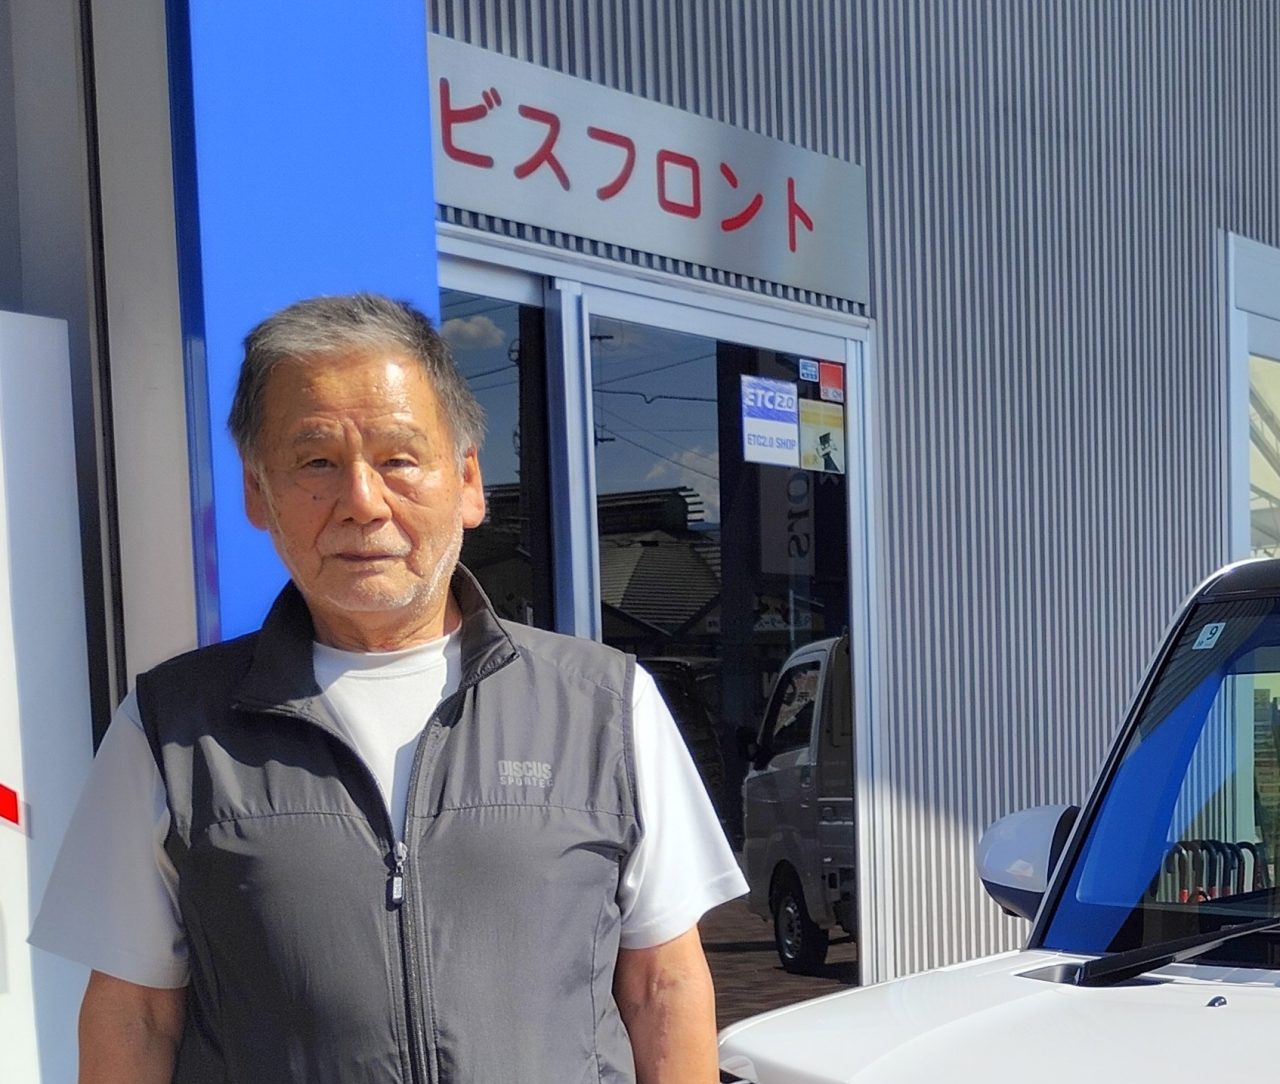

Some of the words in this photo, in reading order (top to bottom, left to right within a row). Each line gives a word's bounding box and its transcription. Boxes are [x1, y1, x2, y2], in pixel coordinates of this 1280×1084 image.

[438, 77, 814, 253] ビスフロント
[1207, 625, 1219, 640] 9
[498, 760, 552, 780] DISCUS
